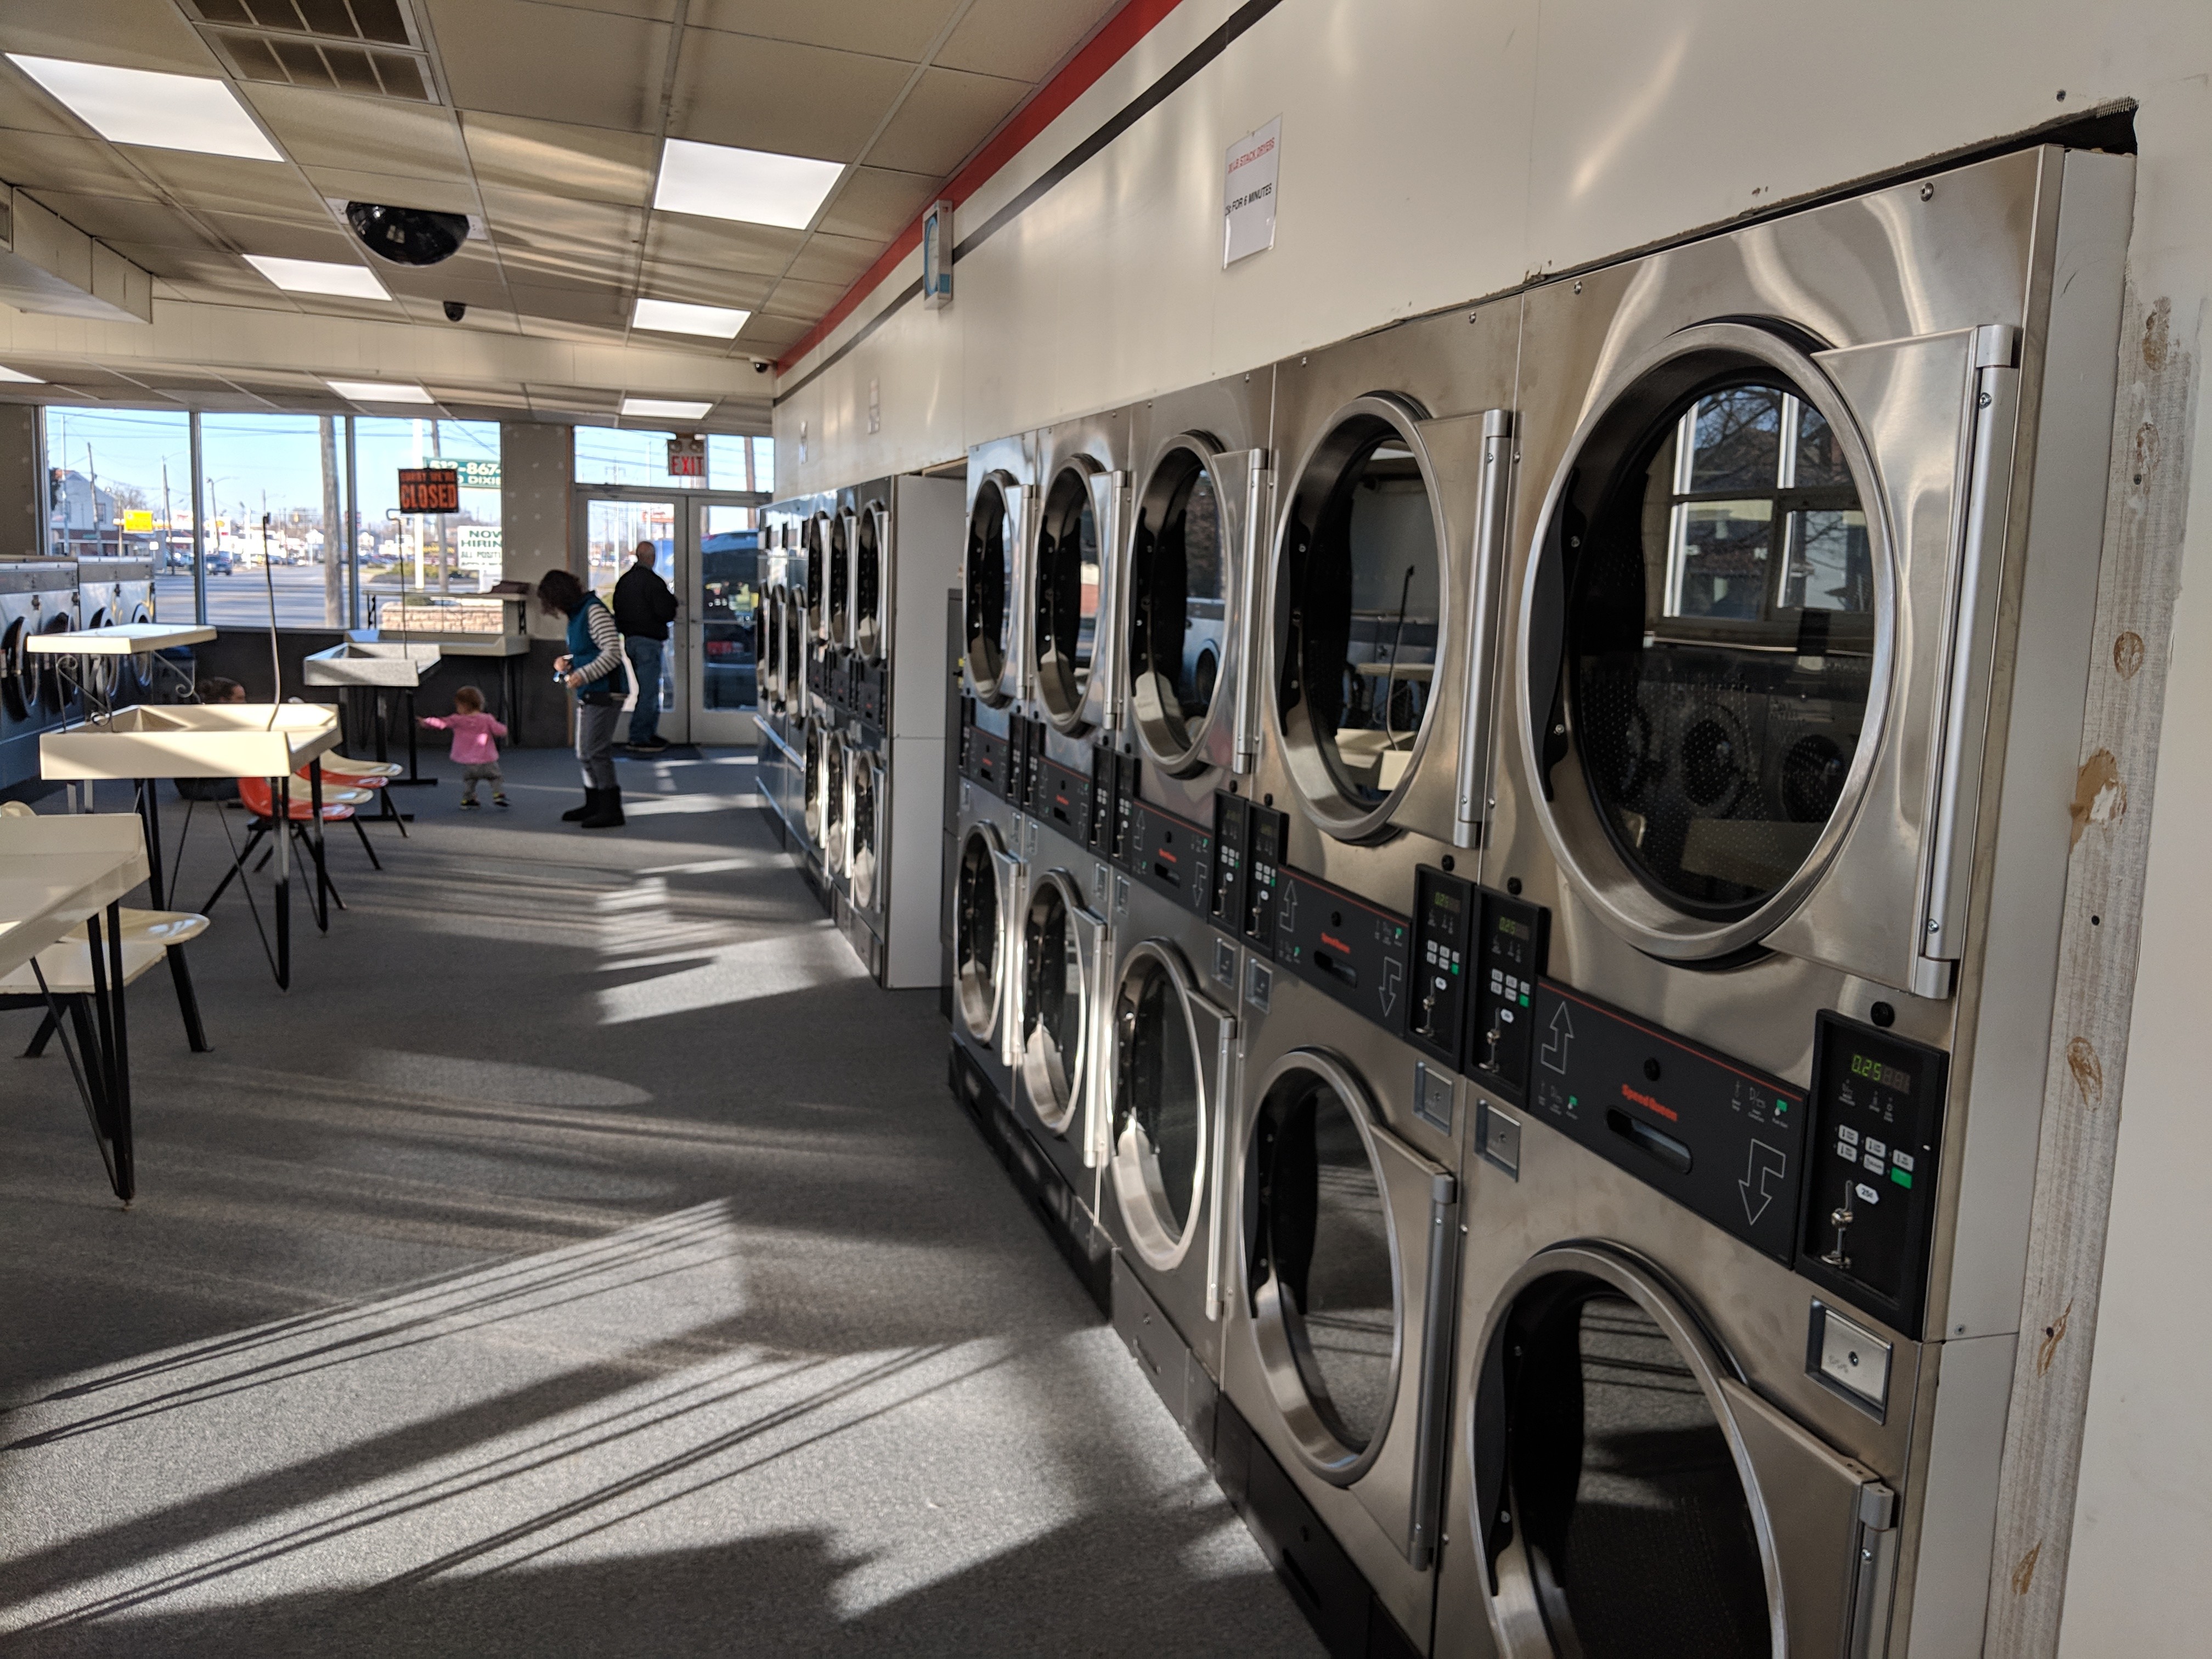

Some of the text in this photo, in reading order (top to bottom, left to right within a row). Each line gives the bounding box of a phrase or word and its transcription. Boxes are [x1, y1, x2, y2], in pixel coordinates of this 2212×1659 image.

[1232, 197, 1243, 212] FOR
[1244, 195, 1248, 206] 6
[1248, 182, 1272, 204] MINUTES
[672, 455, 704, 476] EXIT
[400, 483, 457, 509] CLOSED
